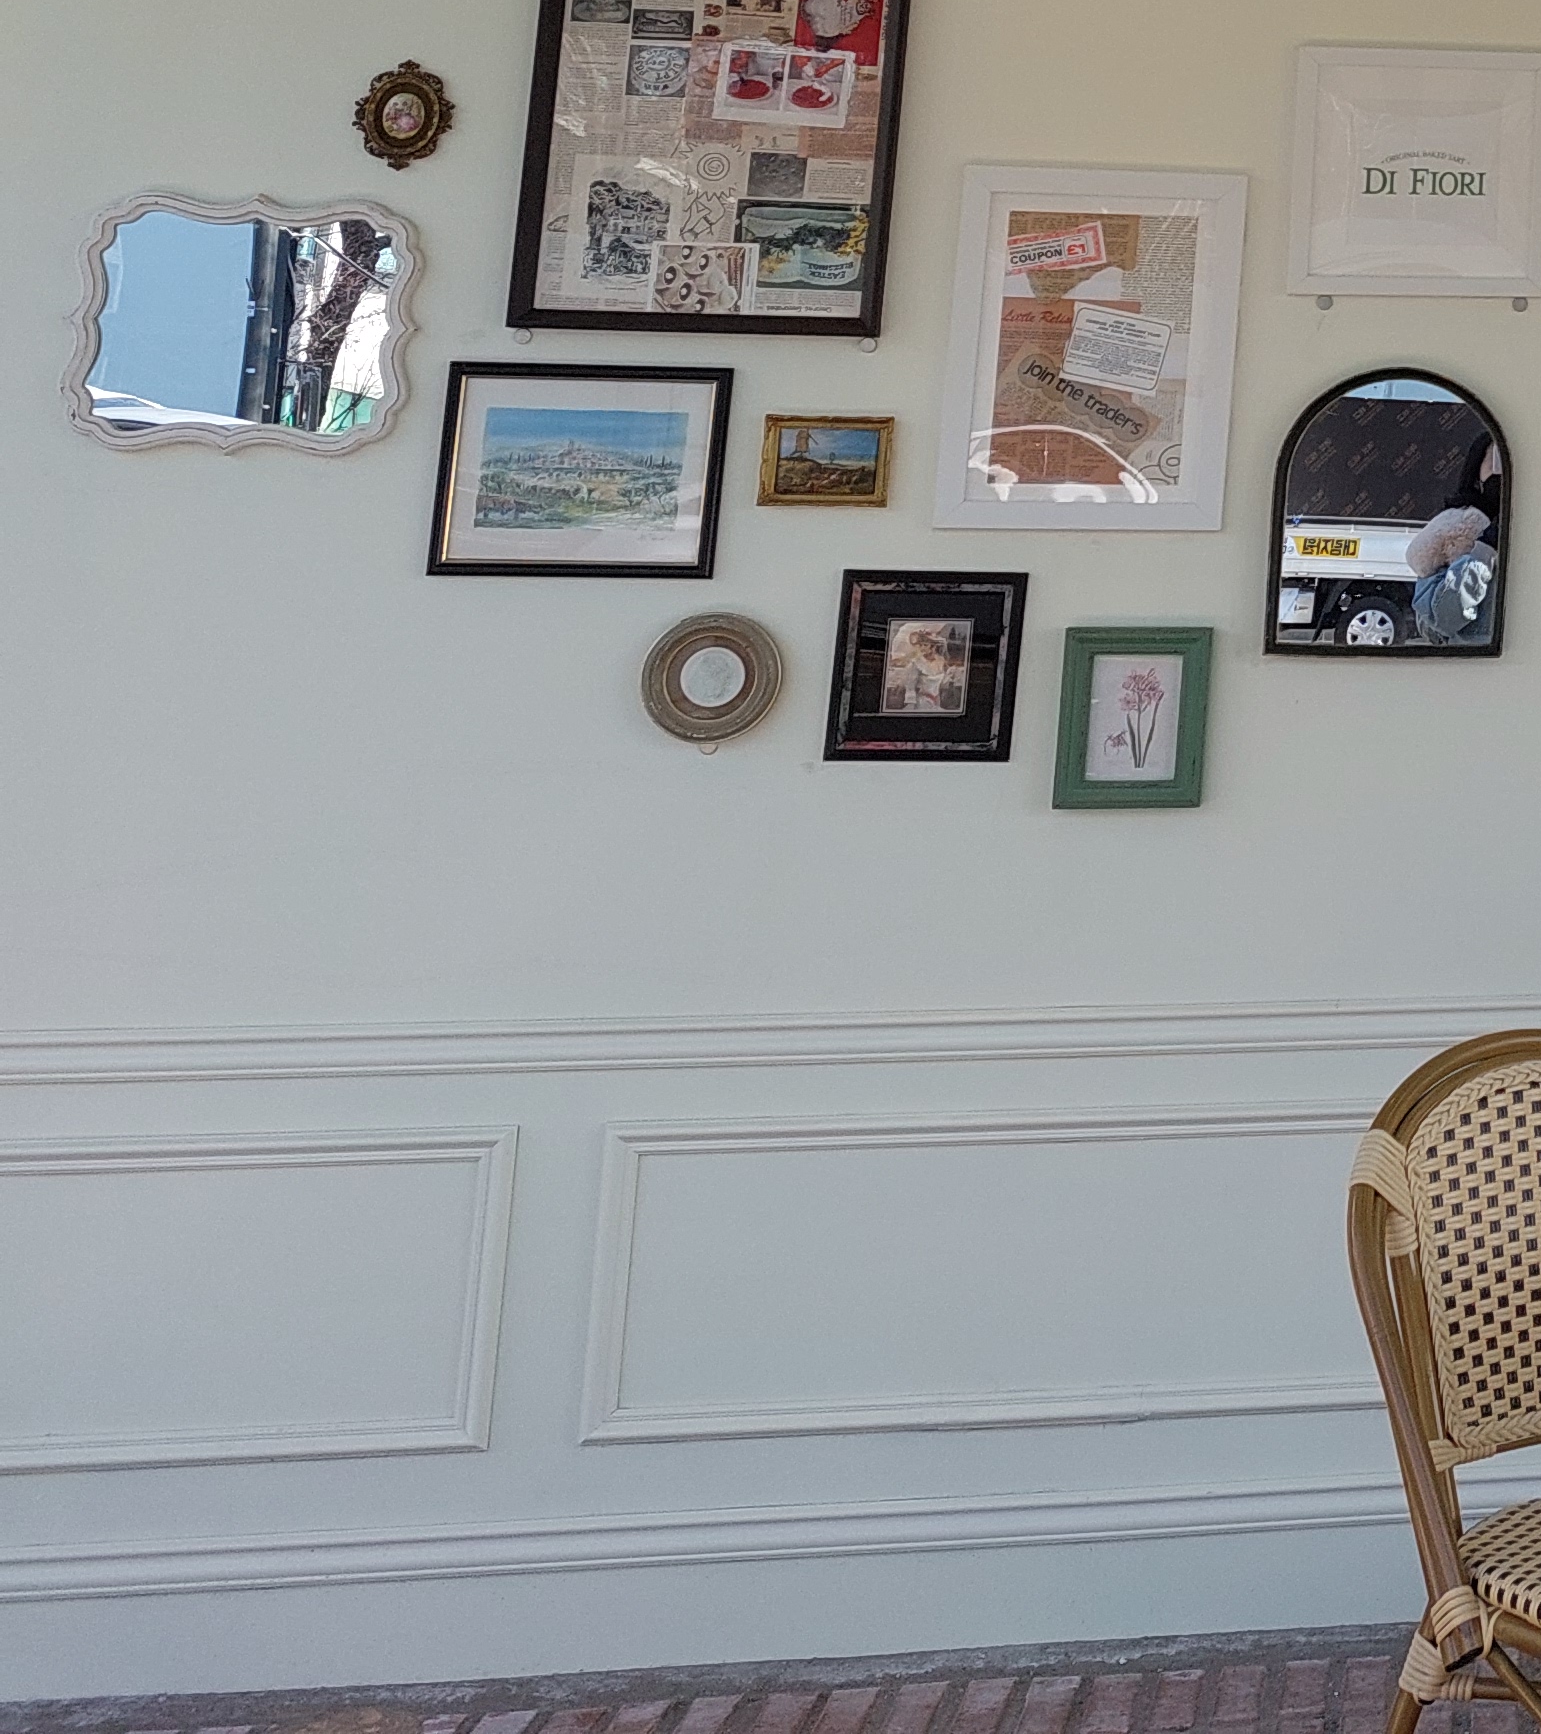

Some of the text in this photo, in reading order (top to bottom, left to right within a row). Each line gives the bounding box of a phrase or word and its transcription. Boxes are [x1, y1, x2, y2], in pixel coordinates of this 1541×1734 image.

[1361, 166, 1487, 197] DI FIORI
[1009, 249, 1063, 265] COUPON
[1055, 377, 1085, 401] the
[1084, 393, 1143, 436] trader's
